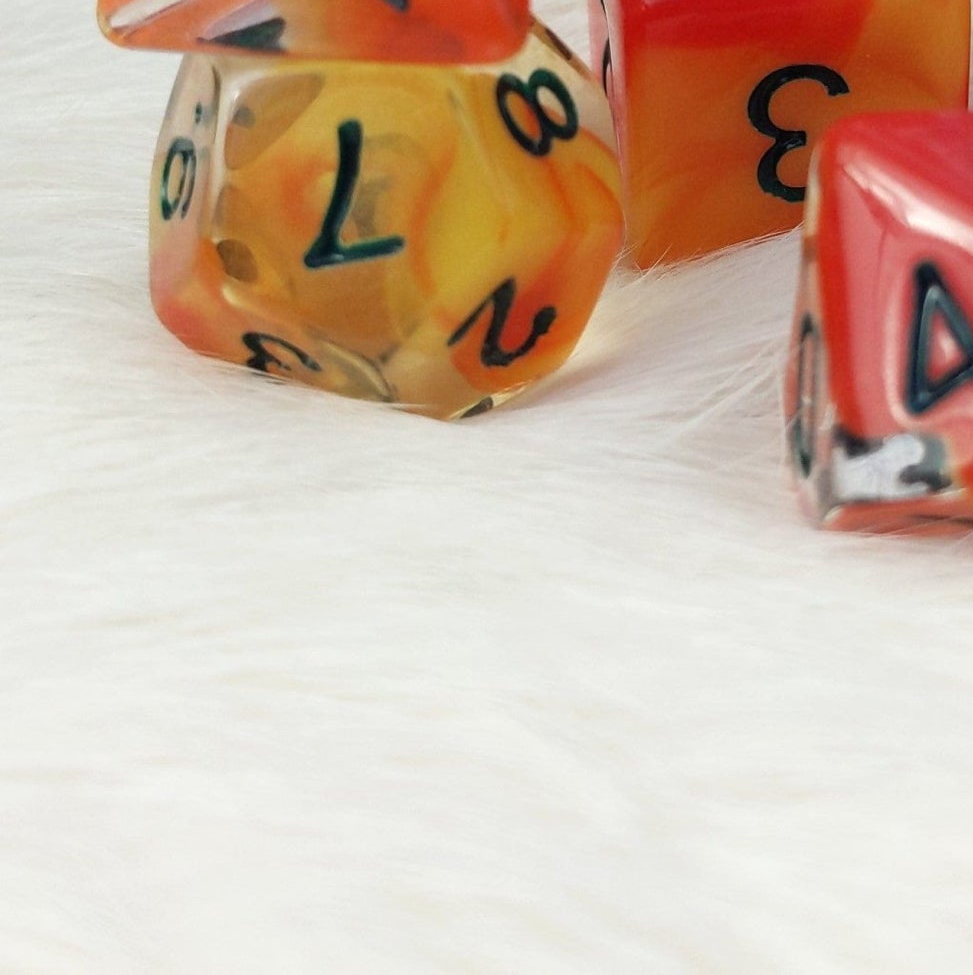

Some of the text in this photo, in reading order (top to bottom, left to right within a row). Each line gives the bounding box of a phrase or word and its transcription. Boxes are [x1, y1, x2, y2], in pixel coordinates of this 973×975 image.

[496, 68, 580, 158] 8
[746, 63, 851, 204] 3
[303, 118, 405, 269] 7
[447, 276, 558, 368] 2
